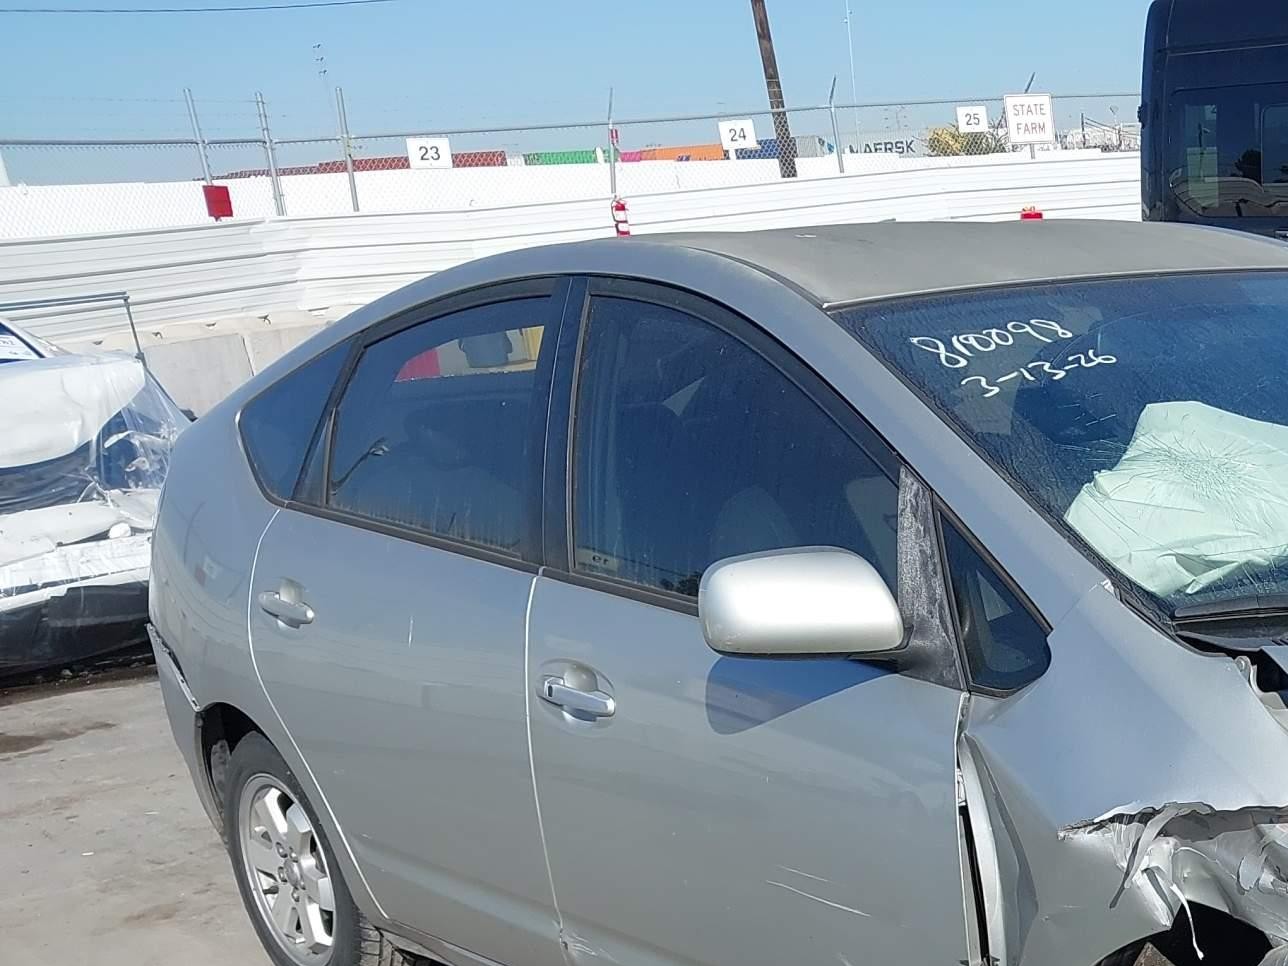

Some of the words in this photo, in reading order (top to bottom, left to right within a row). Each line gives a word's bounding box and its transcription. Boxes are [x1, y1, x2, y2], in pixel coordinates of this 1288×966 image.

[1012, 103, 1047, 117] STATE
[964, 113, 980, 126] 25
[728, 127, 747, 142] 24
[1016, 122, 1046, 135] FARM
[418, 146, 441, 161] 23
[960, 349, 1117, 398] 3-13-26
